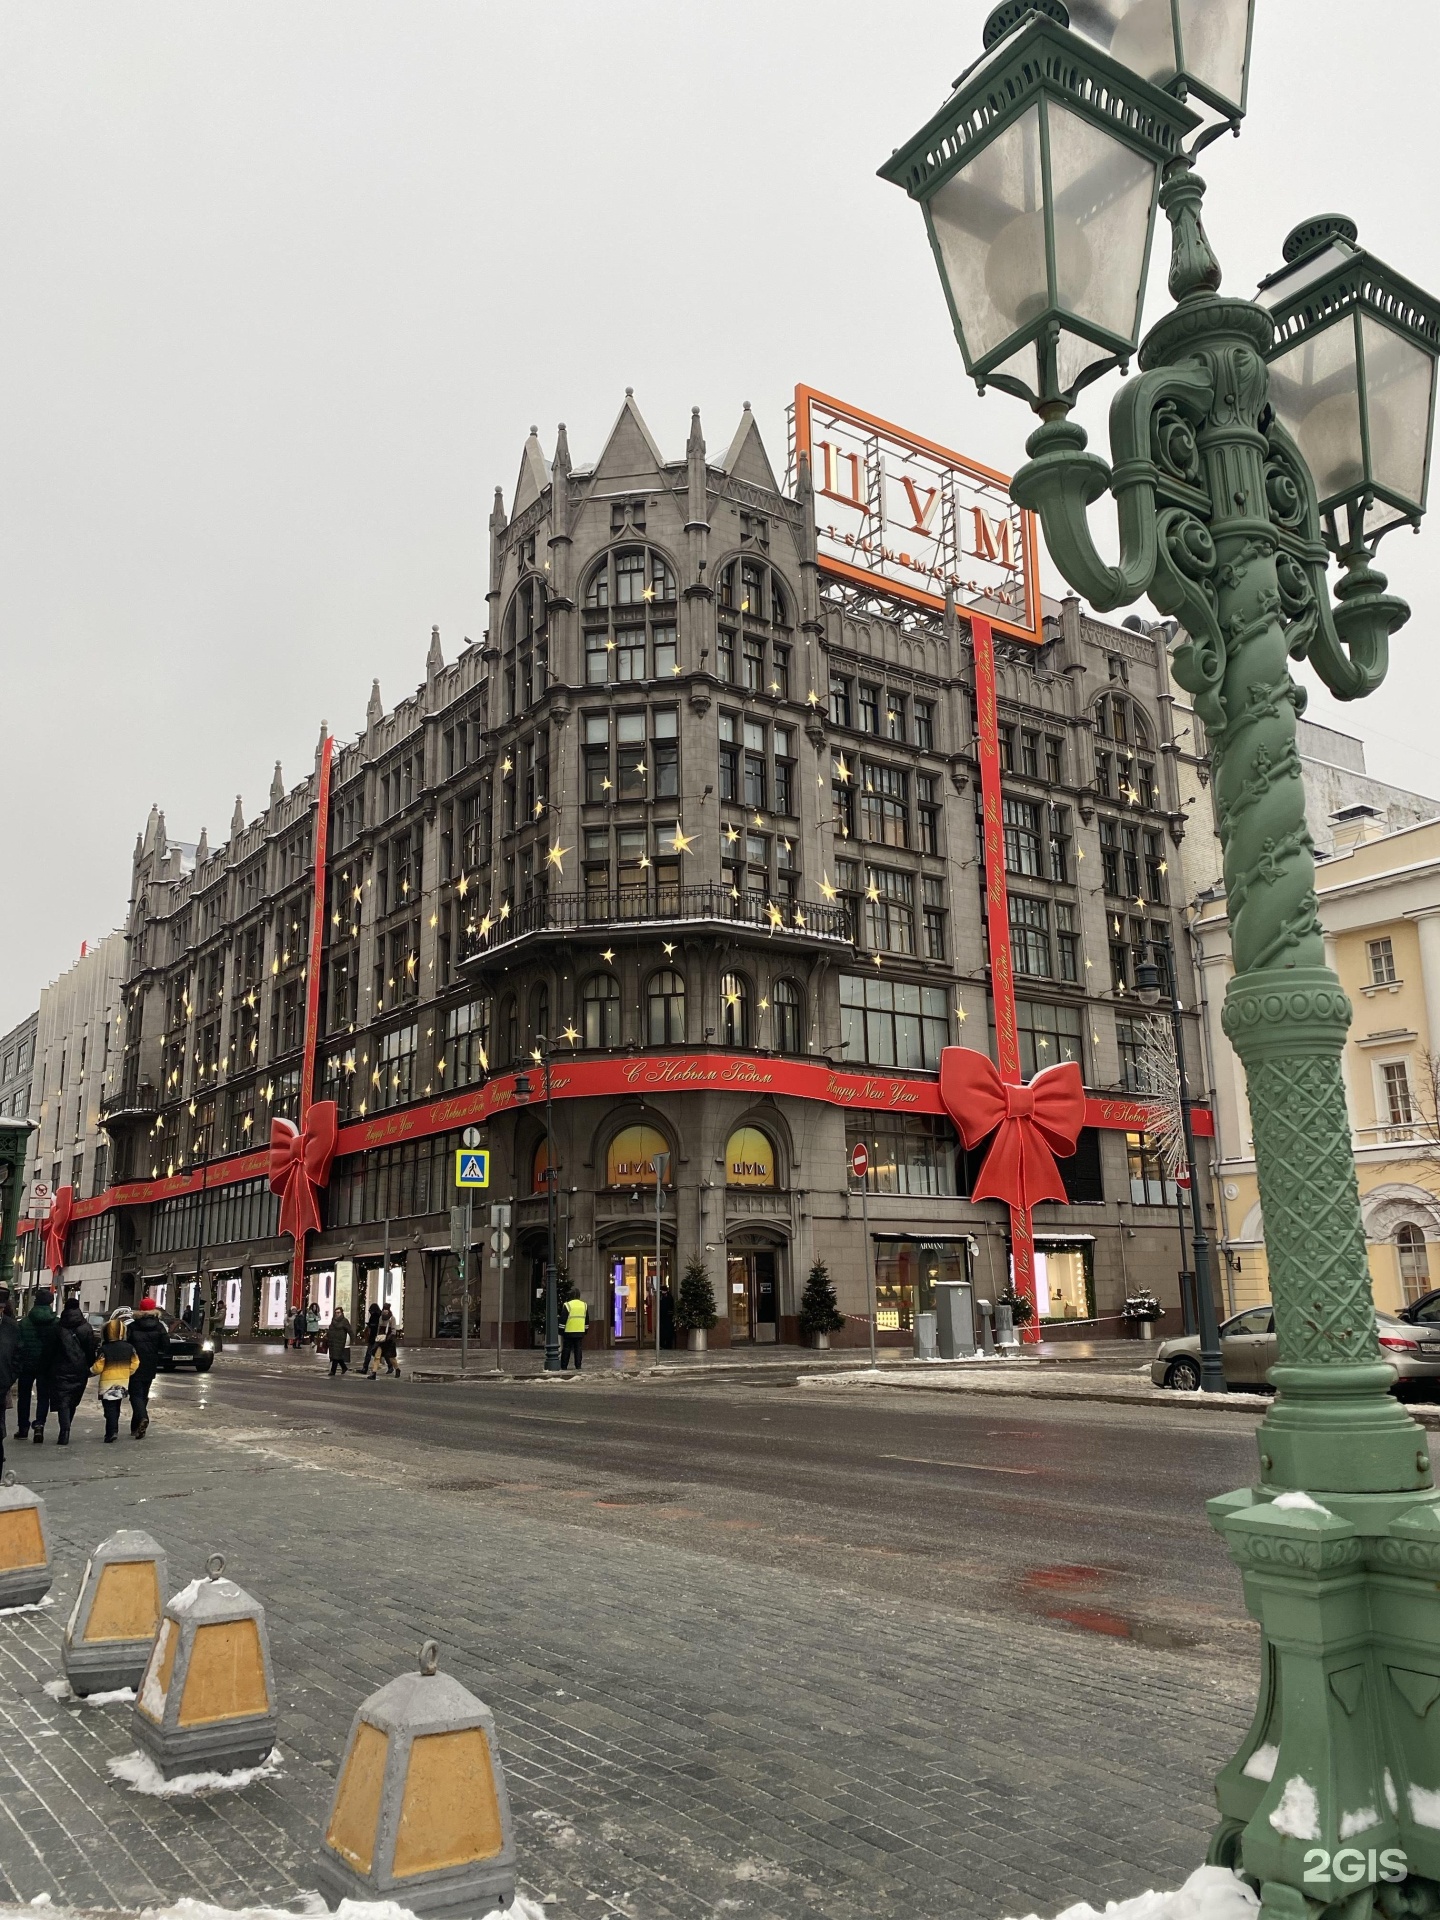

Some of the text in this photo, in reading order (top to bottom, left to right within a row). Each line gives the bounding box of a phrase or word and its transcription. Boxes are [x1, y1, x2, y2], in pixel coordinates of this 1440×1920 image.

[819, 440, 1019, 571] ЦУМ
[827, 524, 1015, 606] TSUM MOSCOW
[622, 1060, 773, 1083] С Новым Годом
[826, 1074, 919, 1105] Happy New Year
[1013, 1203, 1031, 1244] Year
[920, 1242, 944, 1250] ARMANI
[1016, 1248, 1031, 1286] New
